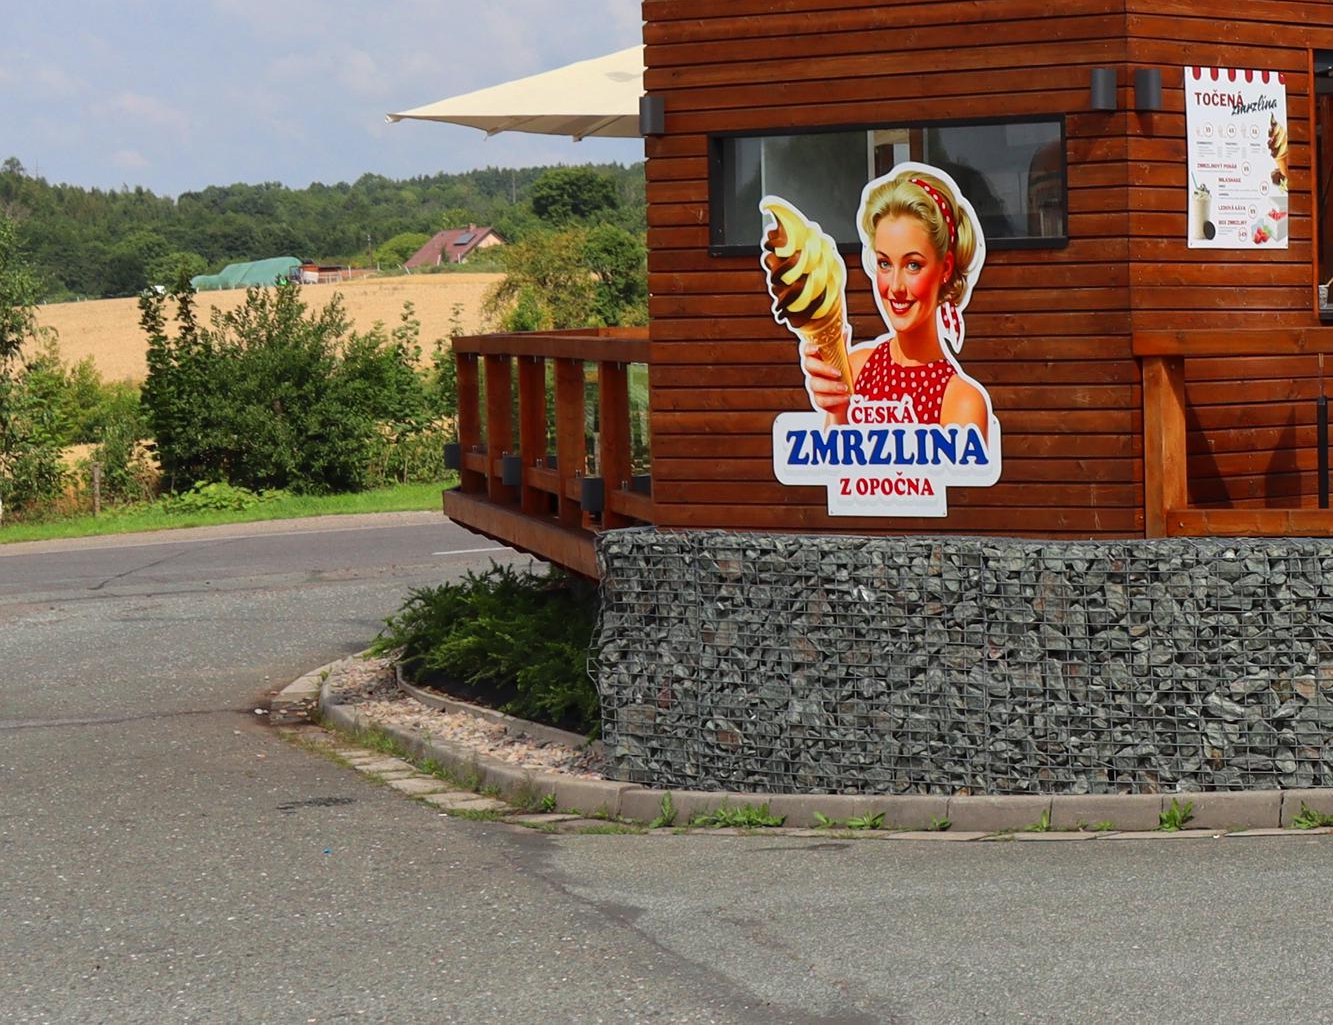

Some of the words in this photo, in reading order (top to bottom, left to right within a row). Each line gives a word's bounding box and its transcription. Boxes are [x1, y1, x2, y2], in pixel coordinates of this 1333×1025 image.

[1194, 90, 1244, 107] TOČENÁ
[851, 399, 914, 424] ČESKÁ
[786, 428, 990, 466] ZMRZLINA
[840, 478, 852, 495] Z
[856, 472, 935, 496] OPOČNA
